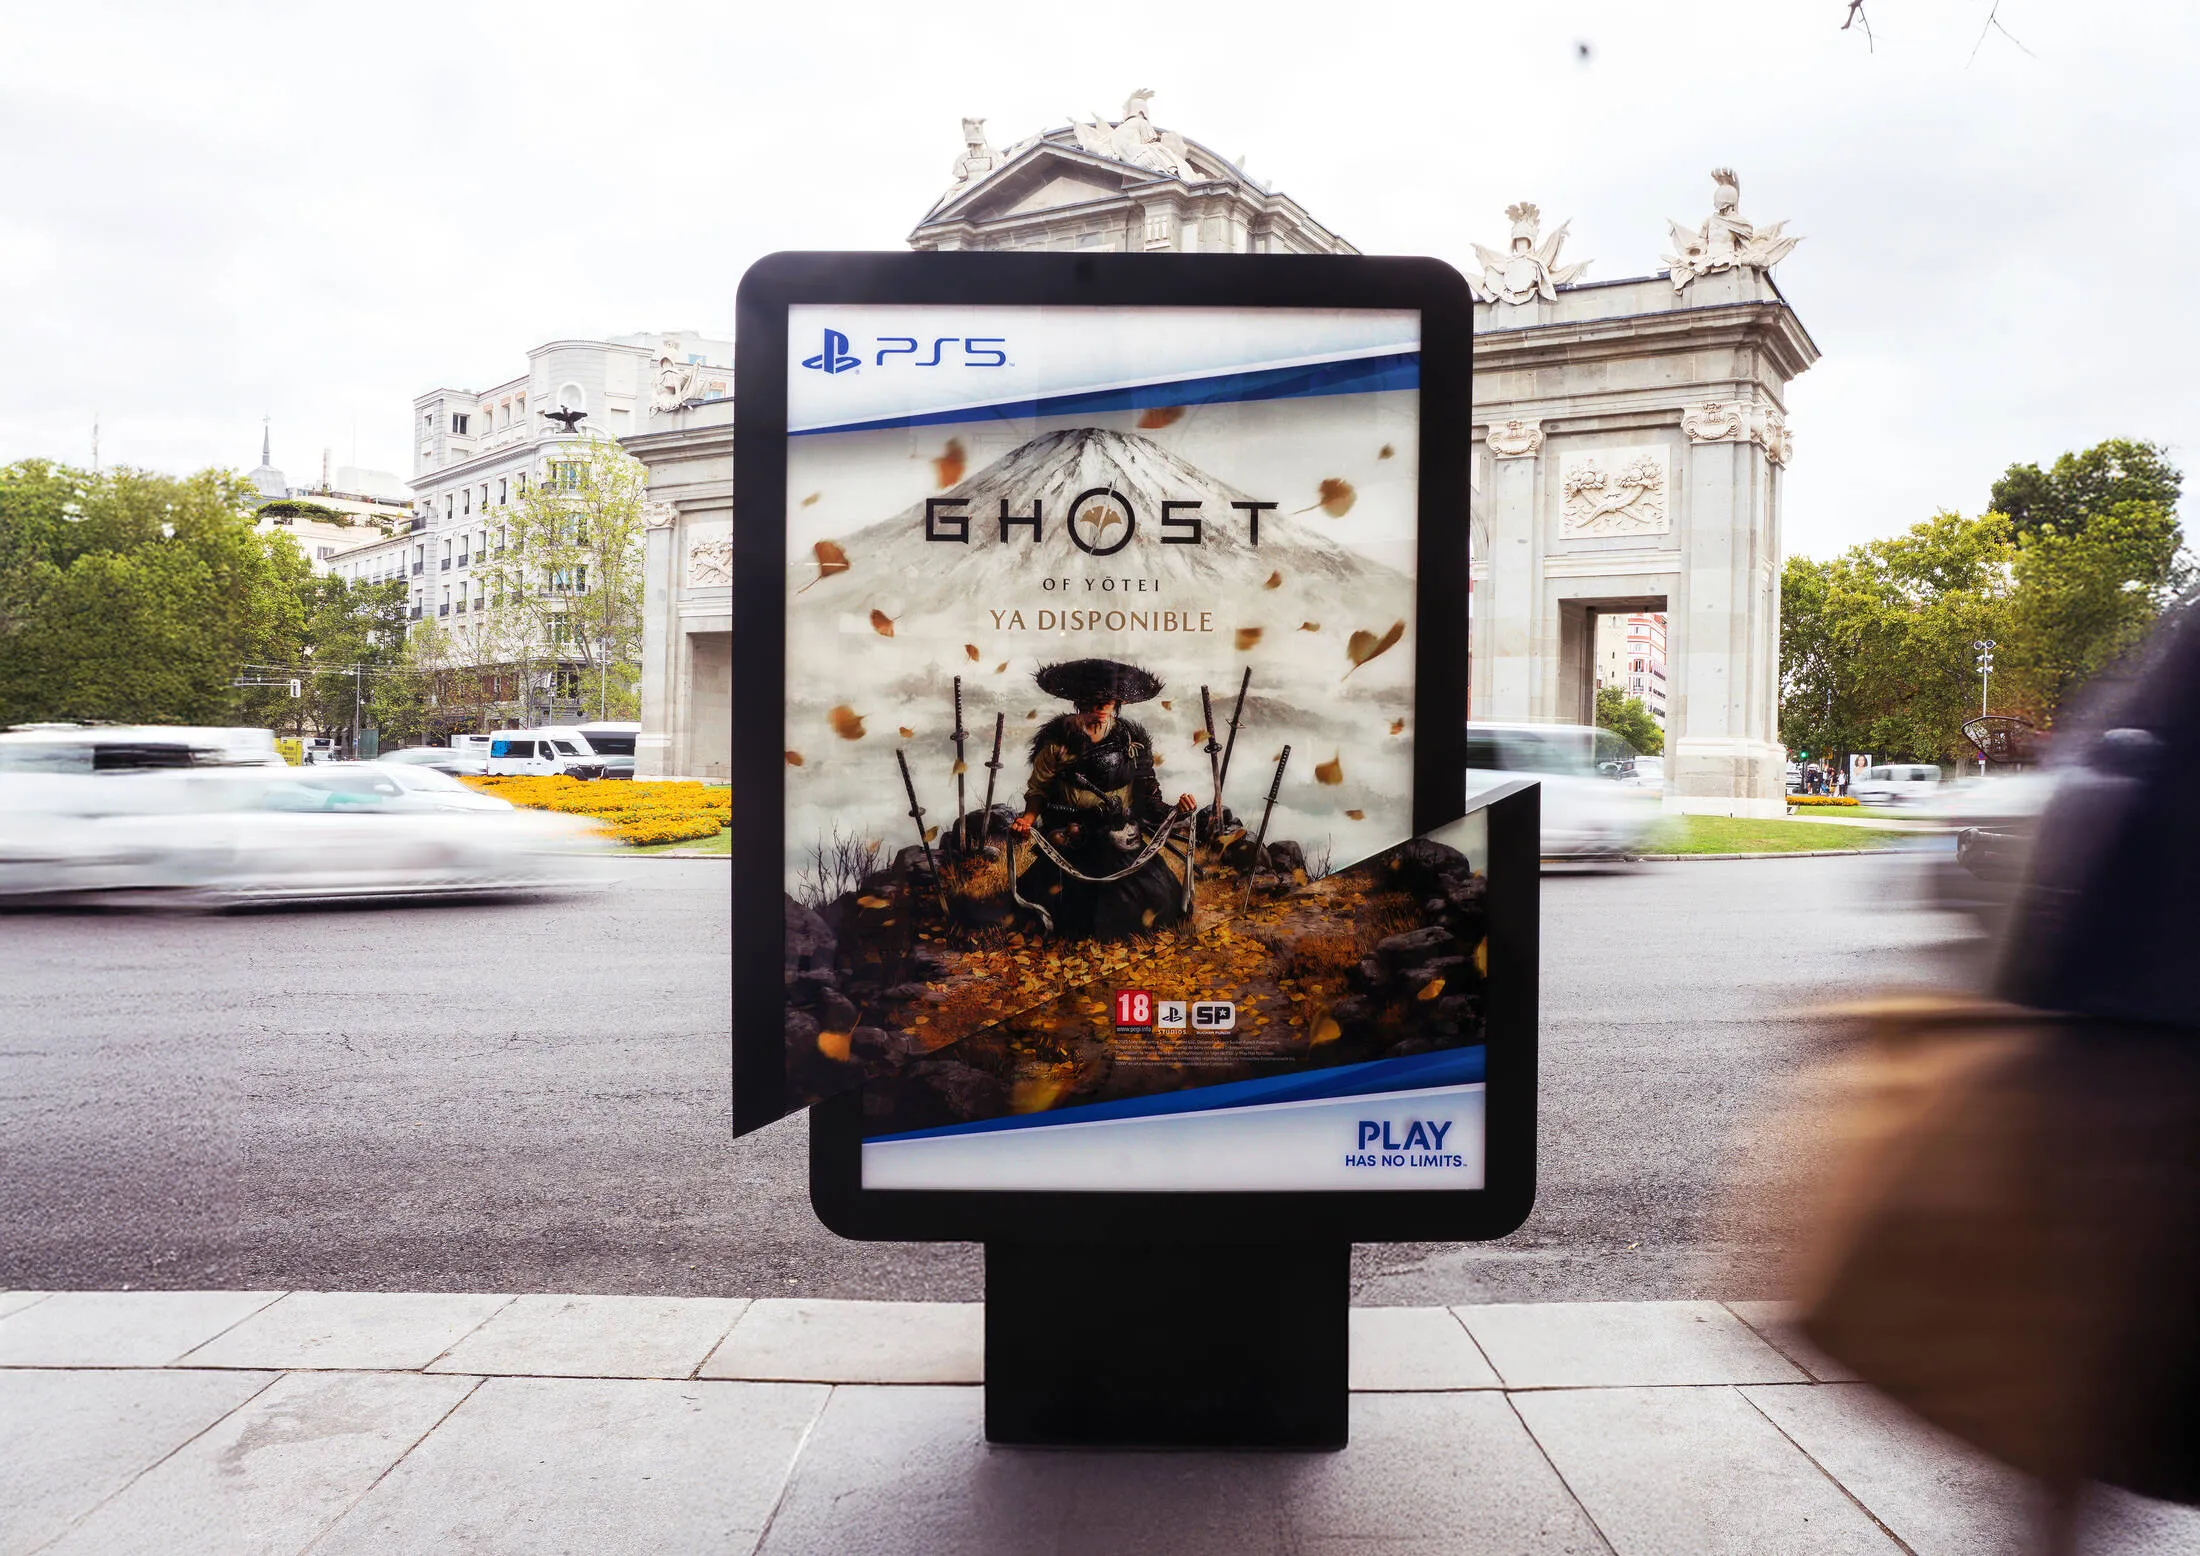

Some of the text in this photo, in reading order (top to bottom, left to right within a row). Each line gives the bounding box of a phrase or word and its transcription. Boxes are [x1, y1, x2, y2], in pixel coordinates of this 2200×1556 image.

[876, 337, 1007, 367] PS5
[925, 487, 1280, 556] GHOST
[1042, 578, 1071, 592] OF
[989, 609, 1214, 633] YA DISPONIBLE
[1118, 993, 1150, 1022] 18
[1196, 1006, 1231, 1025] SP
[1358, 1120, 1453, 1151] PLAY
[1345, 1154, 1377, 1167] HAS
[1381, 1154, 1406, 1167] NO
